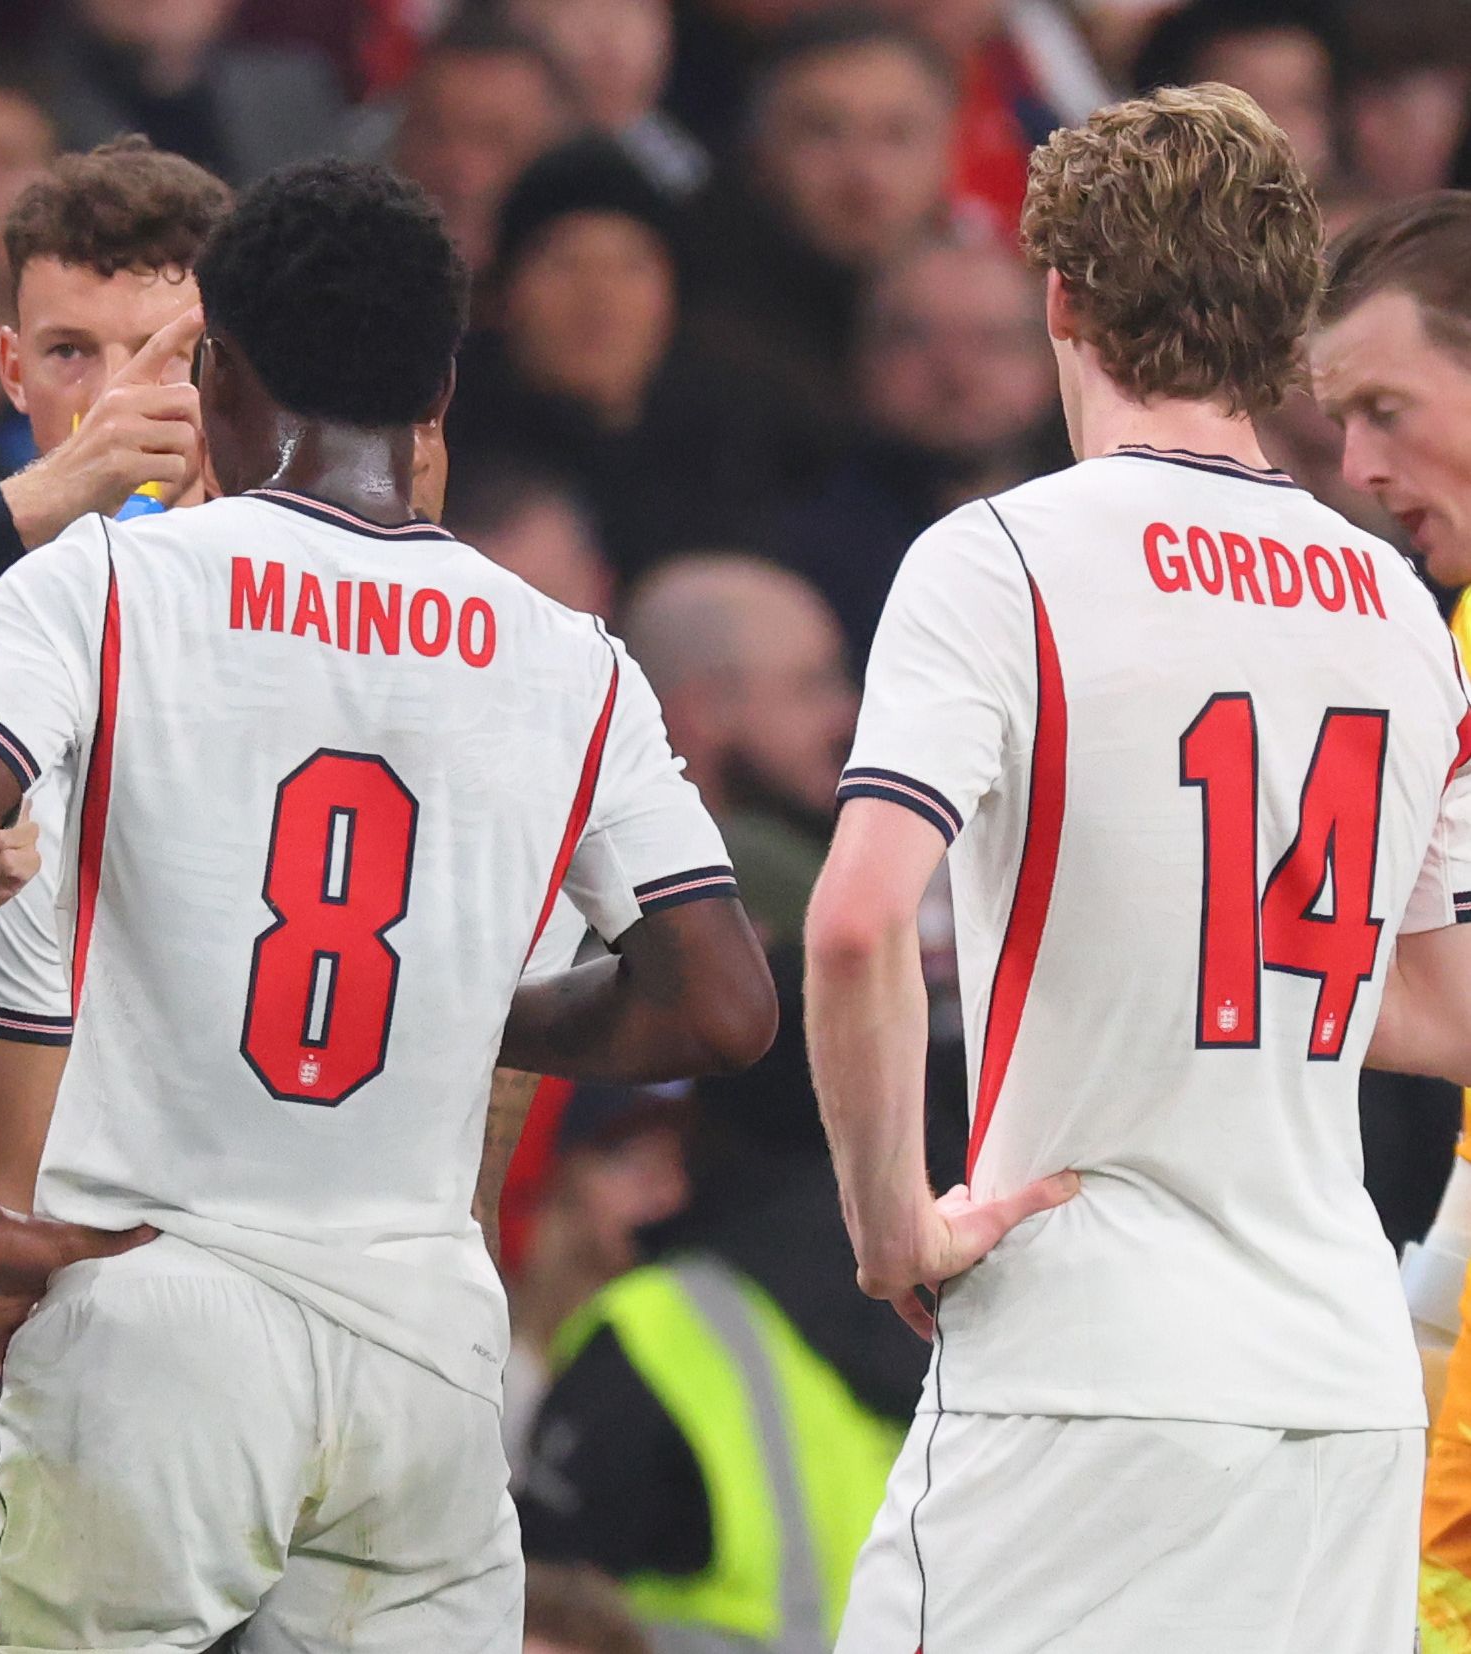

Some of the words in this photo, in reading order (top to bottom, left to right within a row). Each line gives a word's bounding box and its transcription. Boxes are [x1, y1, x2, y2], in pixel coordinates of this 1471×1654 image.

[229, 556, 497, 669] MAINOO
[1143, 521, 1388, 620] GORDON
[239, 747, 419, 1107] 8
[1179, 691, 1390, 1062] 14
